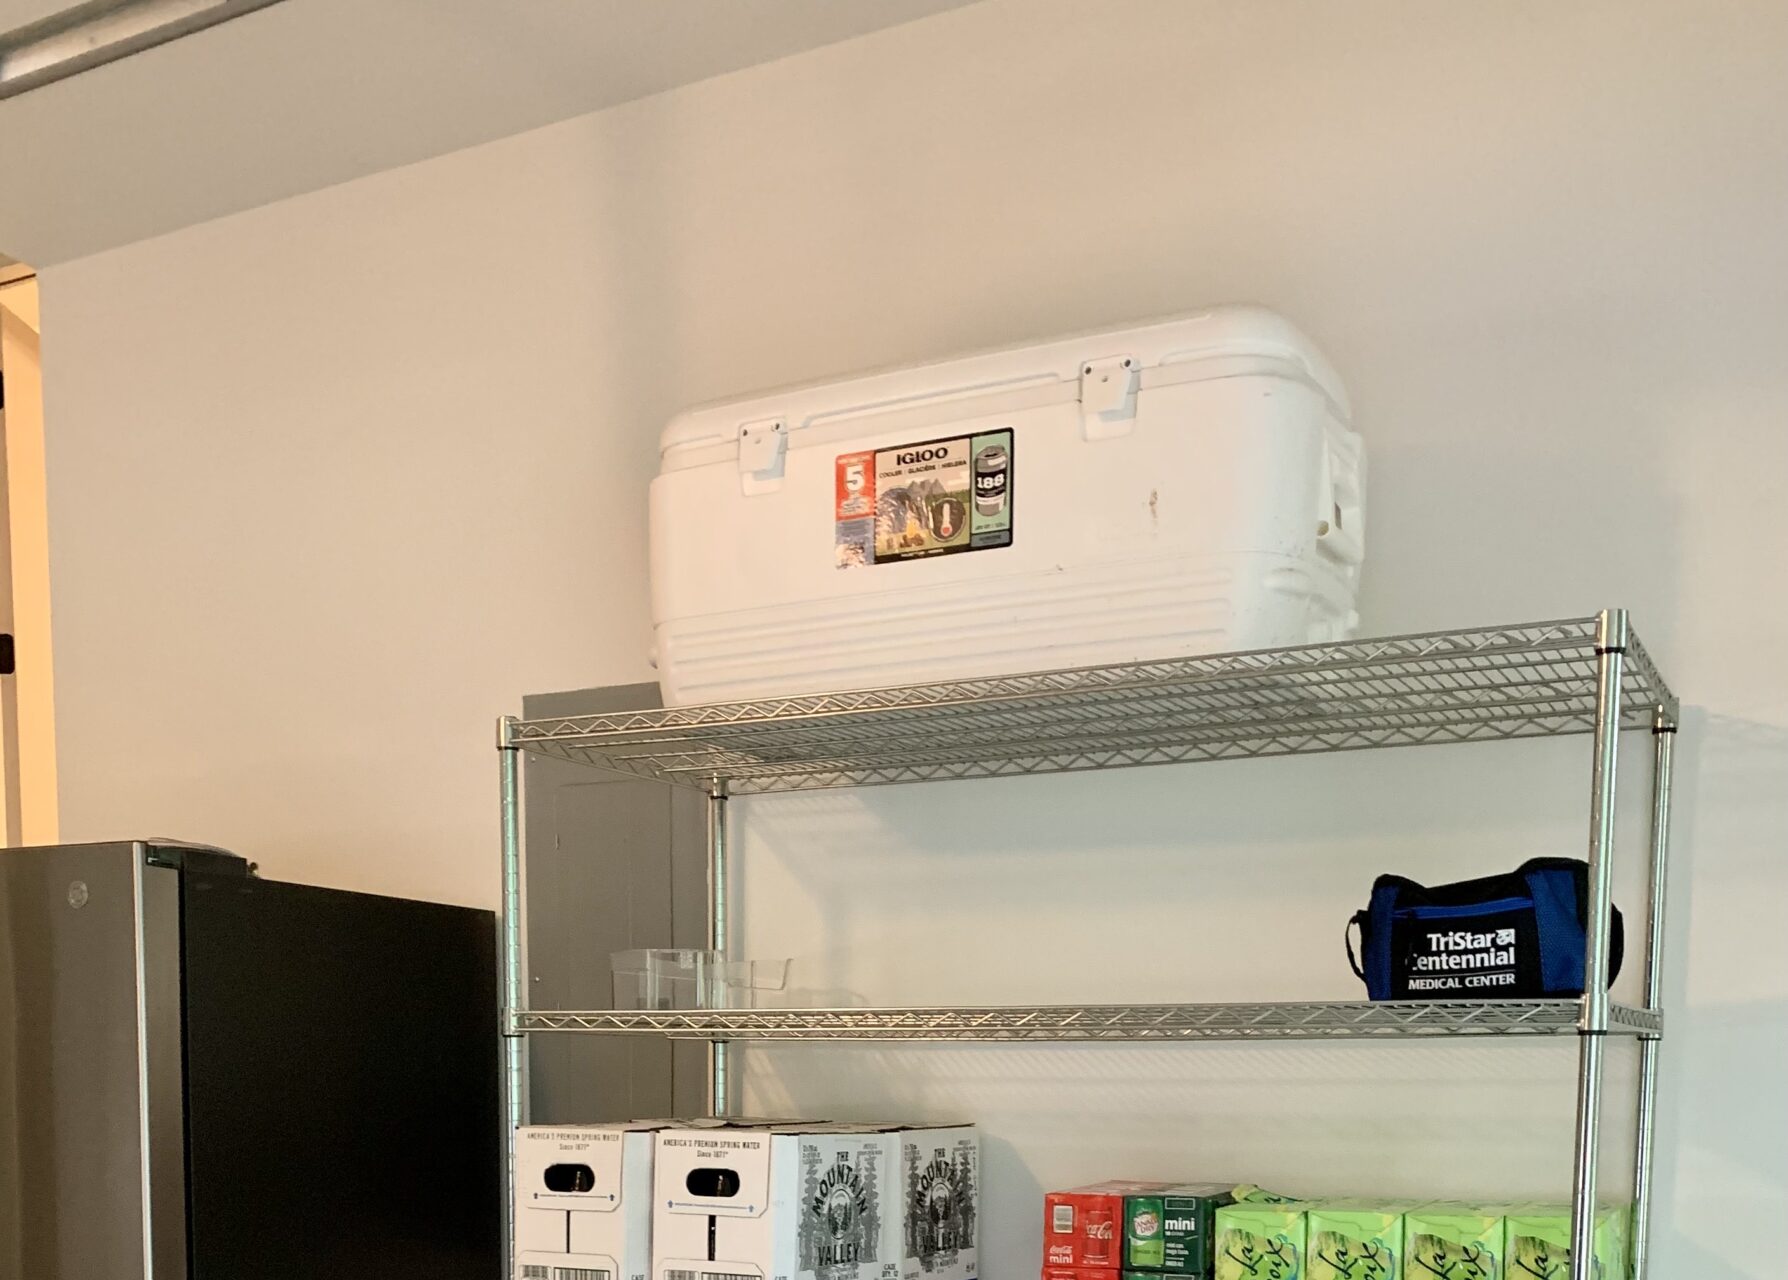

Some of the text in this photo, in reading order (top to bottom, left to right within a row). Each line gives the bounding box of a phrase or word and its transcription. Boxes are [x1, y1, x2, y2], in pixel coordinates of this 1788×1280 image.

[897, 447, 948, 466] IGLOO
[846, 464, 864, 491] 5
[976, 473, 1004, 489] 188
[1427, 931, 1498, 952] TriStar
[1408, 973, 1516, 991] MEDICAL CENTER
[581, 1134, 601, 1142] SPRING
[602, 1134, 620, 1142] WATER
[719, 1141, 741, 1149] SPRING
[742, 1141, 761, 1149] WATER
[836, 1151, 849, 1162] THE
[934, 1148, 946, 1158] THE
[811, 1163, 868, 1217] MOUNTAIN
[1165, 1217, 1195, 1231] mini
[818, 1241, 860, 1266] VALLEY
[1049, 1254, 1073, 1264] mini
